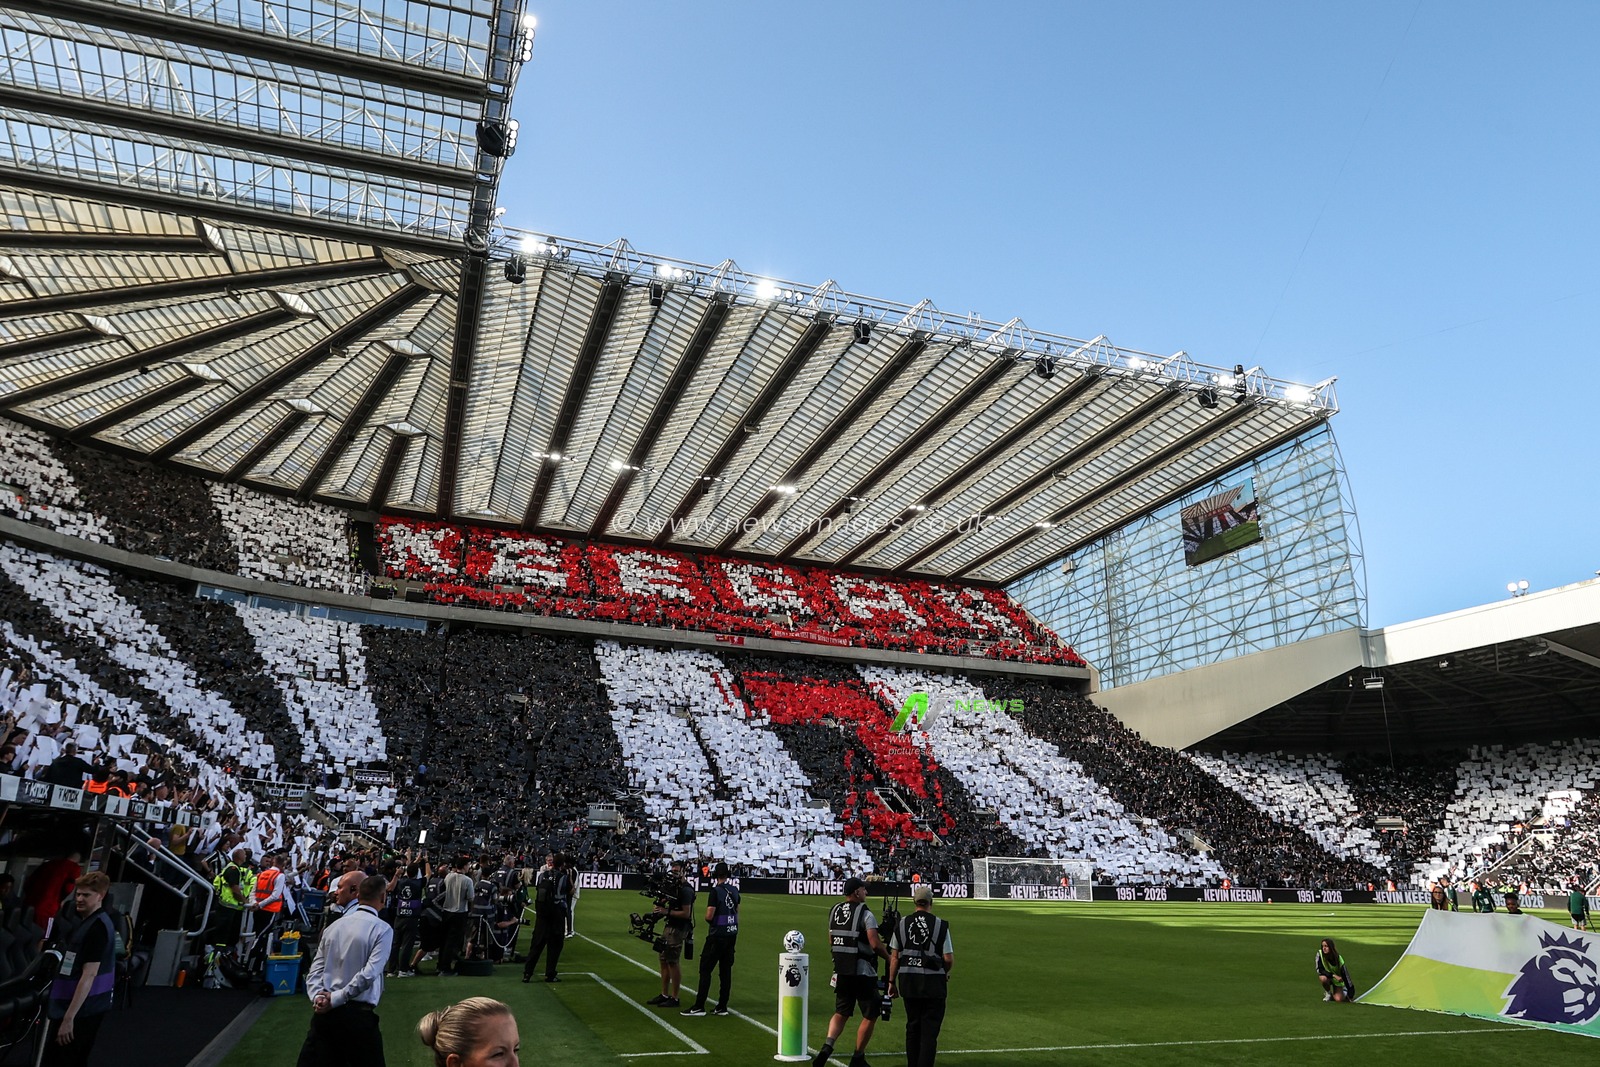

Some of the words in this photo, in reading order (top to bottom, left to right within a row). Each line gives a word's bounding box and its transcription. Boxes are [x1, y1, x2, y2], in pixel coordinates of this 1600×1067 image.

[579, 873, 622, 889] KEEGAN
[788, 880, 821, 895] KEVIN
[942, 883, 968, 898] 2026
[1010, 885, 1039, 899] KEVIN
[1115, 887, 1136, 901] 1951
[1144, 887, 1167, 901] 2026
[1203, 888, 1228, 902] KEVIN
[1230, 889, 1263, 903] KEEGAN
[1297, 890, 1315, 903] 1951
[1321, 890, 1342, 903] 2026
[1375, 891, 1403, 904] KEVIN
[1404, 891, 1431, 904] KEEG
[1518, 894, 1545, 908] 2026
